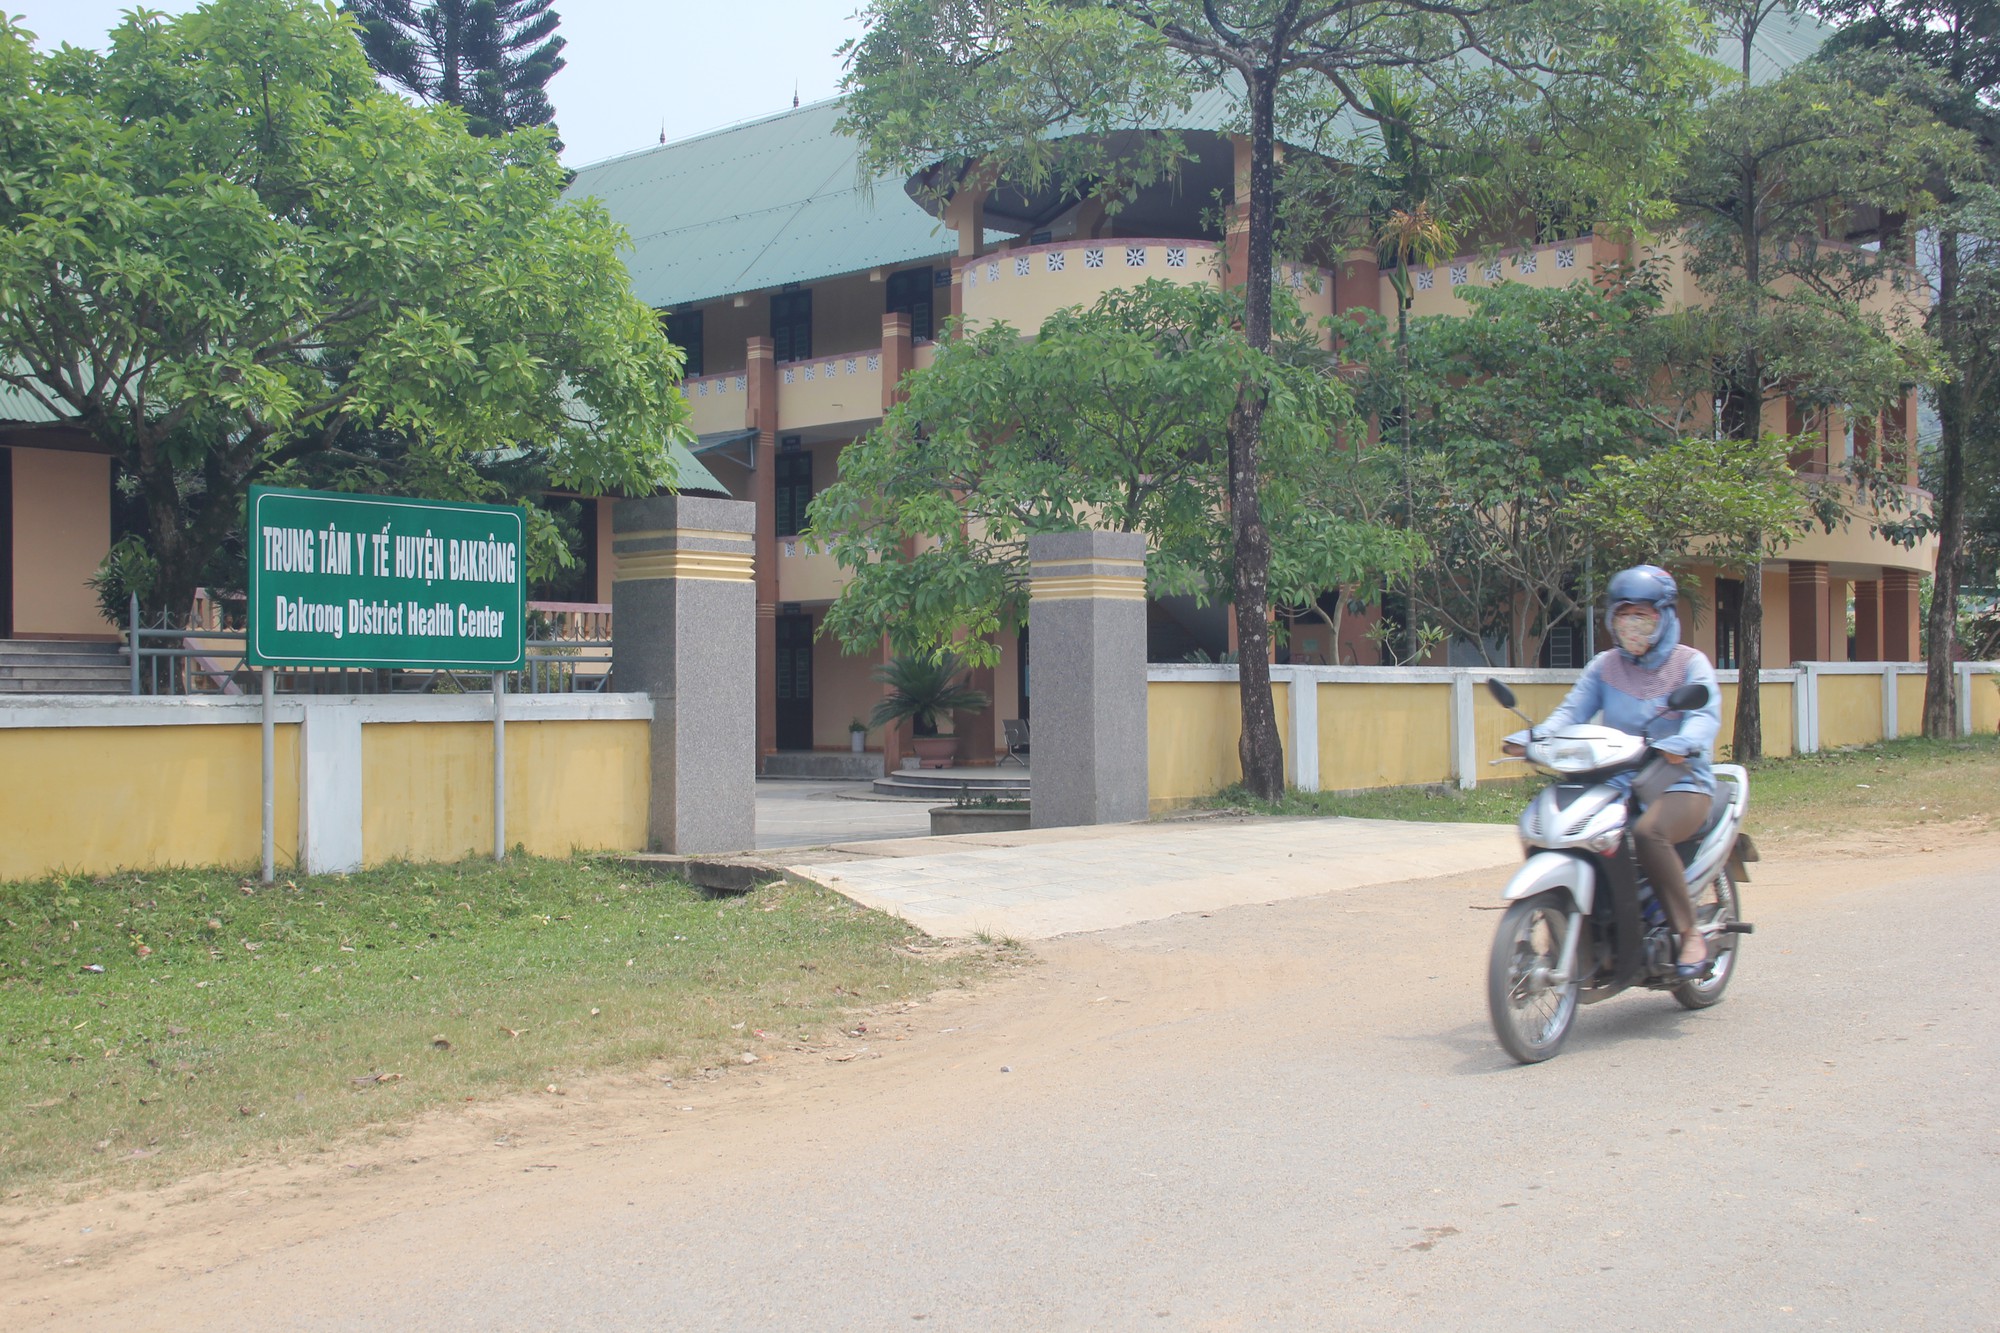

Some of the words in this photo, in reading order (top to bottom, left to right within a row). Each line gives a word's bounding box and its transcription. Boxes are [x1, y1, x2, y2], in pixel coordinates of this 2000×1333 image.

[263, 526, 314, 573] TRUNG
[319, 522, 351, 575] TÂM
[357, 533, 366, 576] Y
[372, 522, 390, 577] TẾ
[396, 529, 444, 586] HUYỆN
[450, 533, 516, 583] ĐAKRÔNG
[276, 595, 343, 639] Dakrong
[349, 599, 403, 635] District
[408, 601, 454, 636] Health
[458, 603, 504, 638] Center
